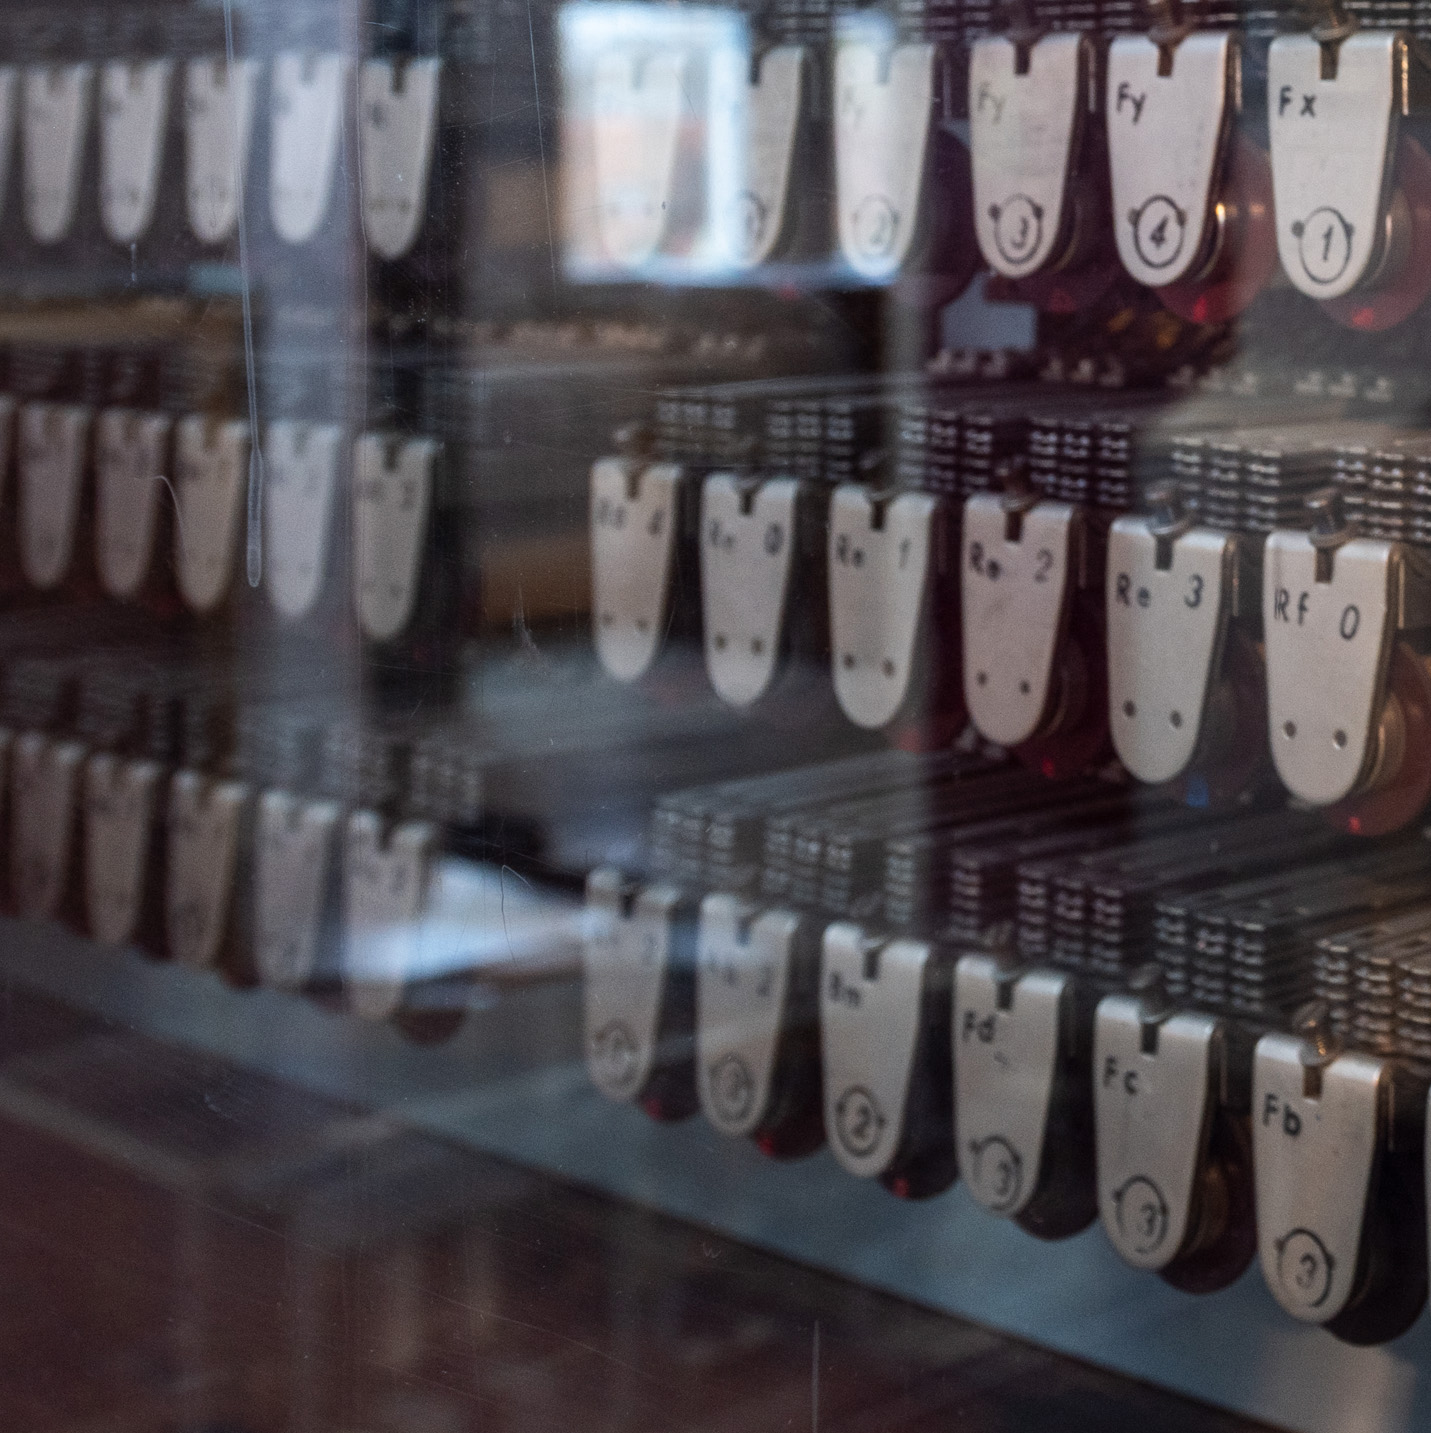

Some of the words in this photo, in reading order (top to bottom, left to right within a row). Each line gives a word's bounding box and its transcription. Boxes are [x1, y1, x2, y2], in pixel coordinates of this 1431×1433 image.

[1115, 81, 1147, 126] Fy
[1277, 85, 1318, 118] Fx
[1150, 215, 1170, 250] 4
[1033, 547, 1054, 585] 2
[1184, 572, 1206, 610] 3
